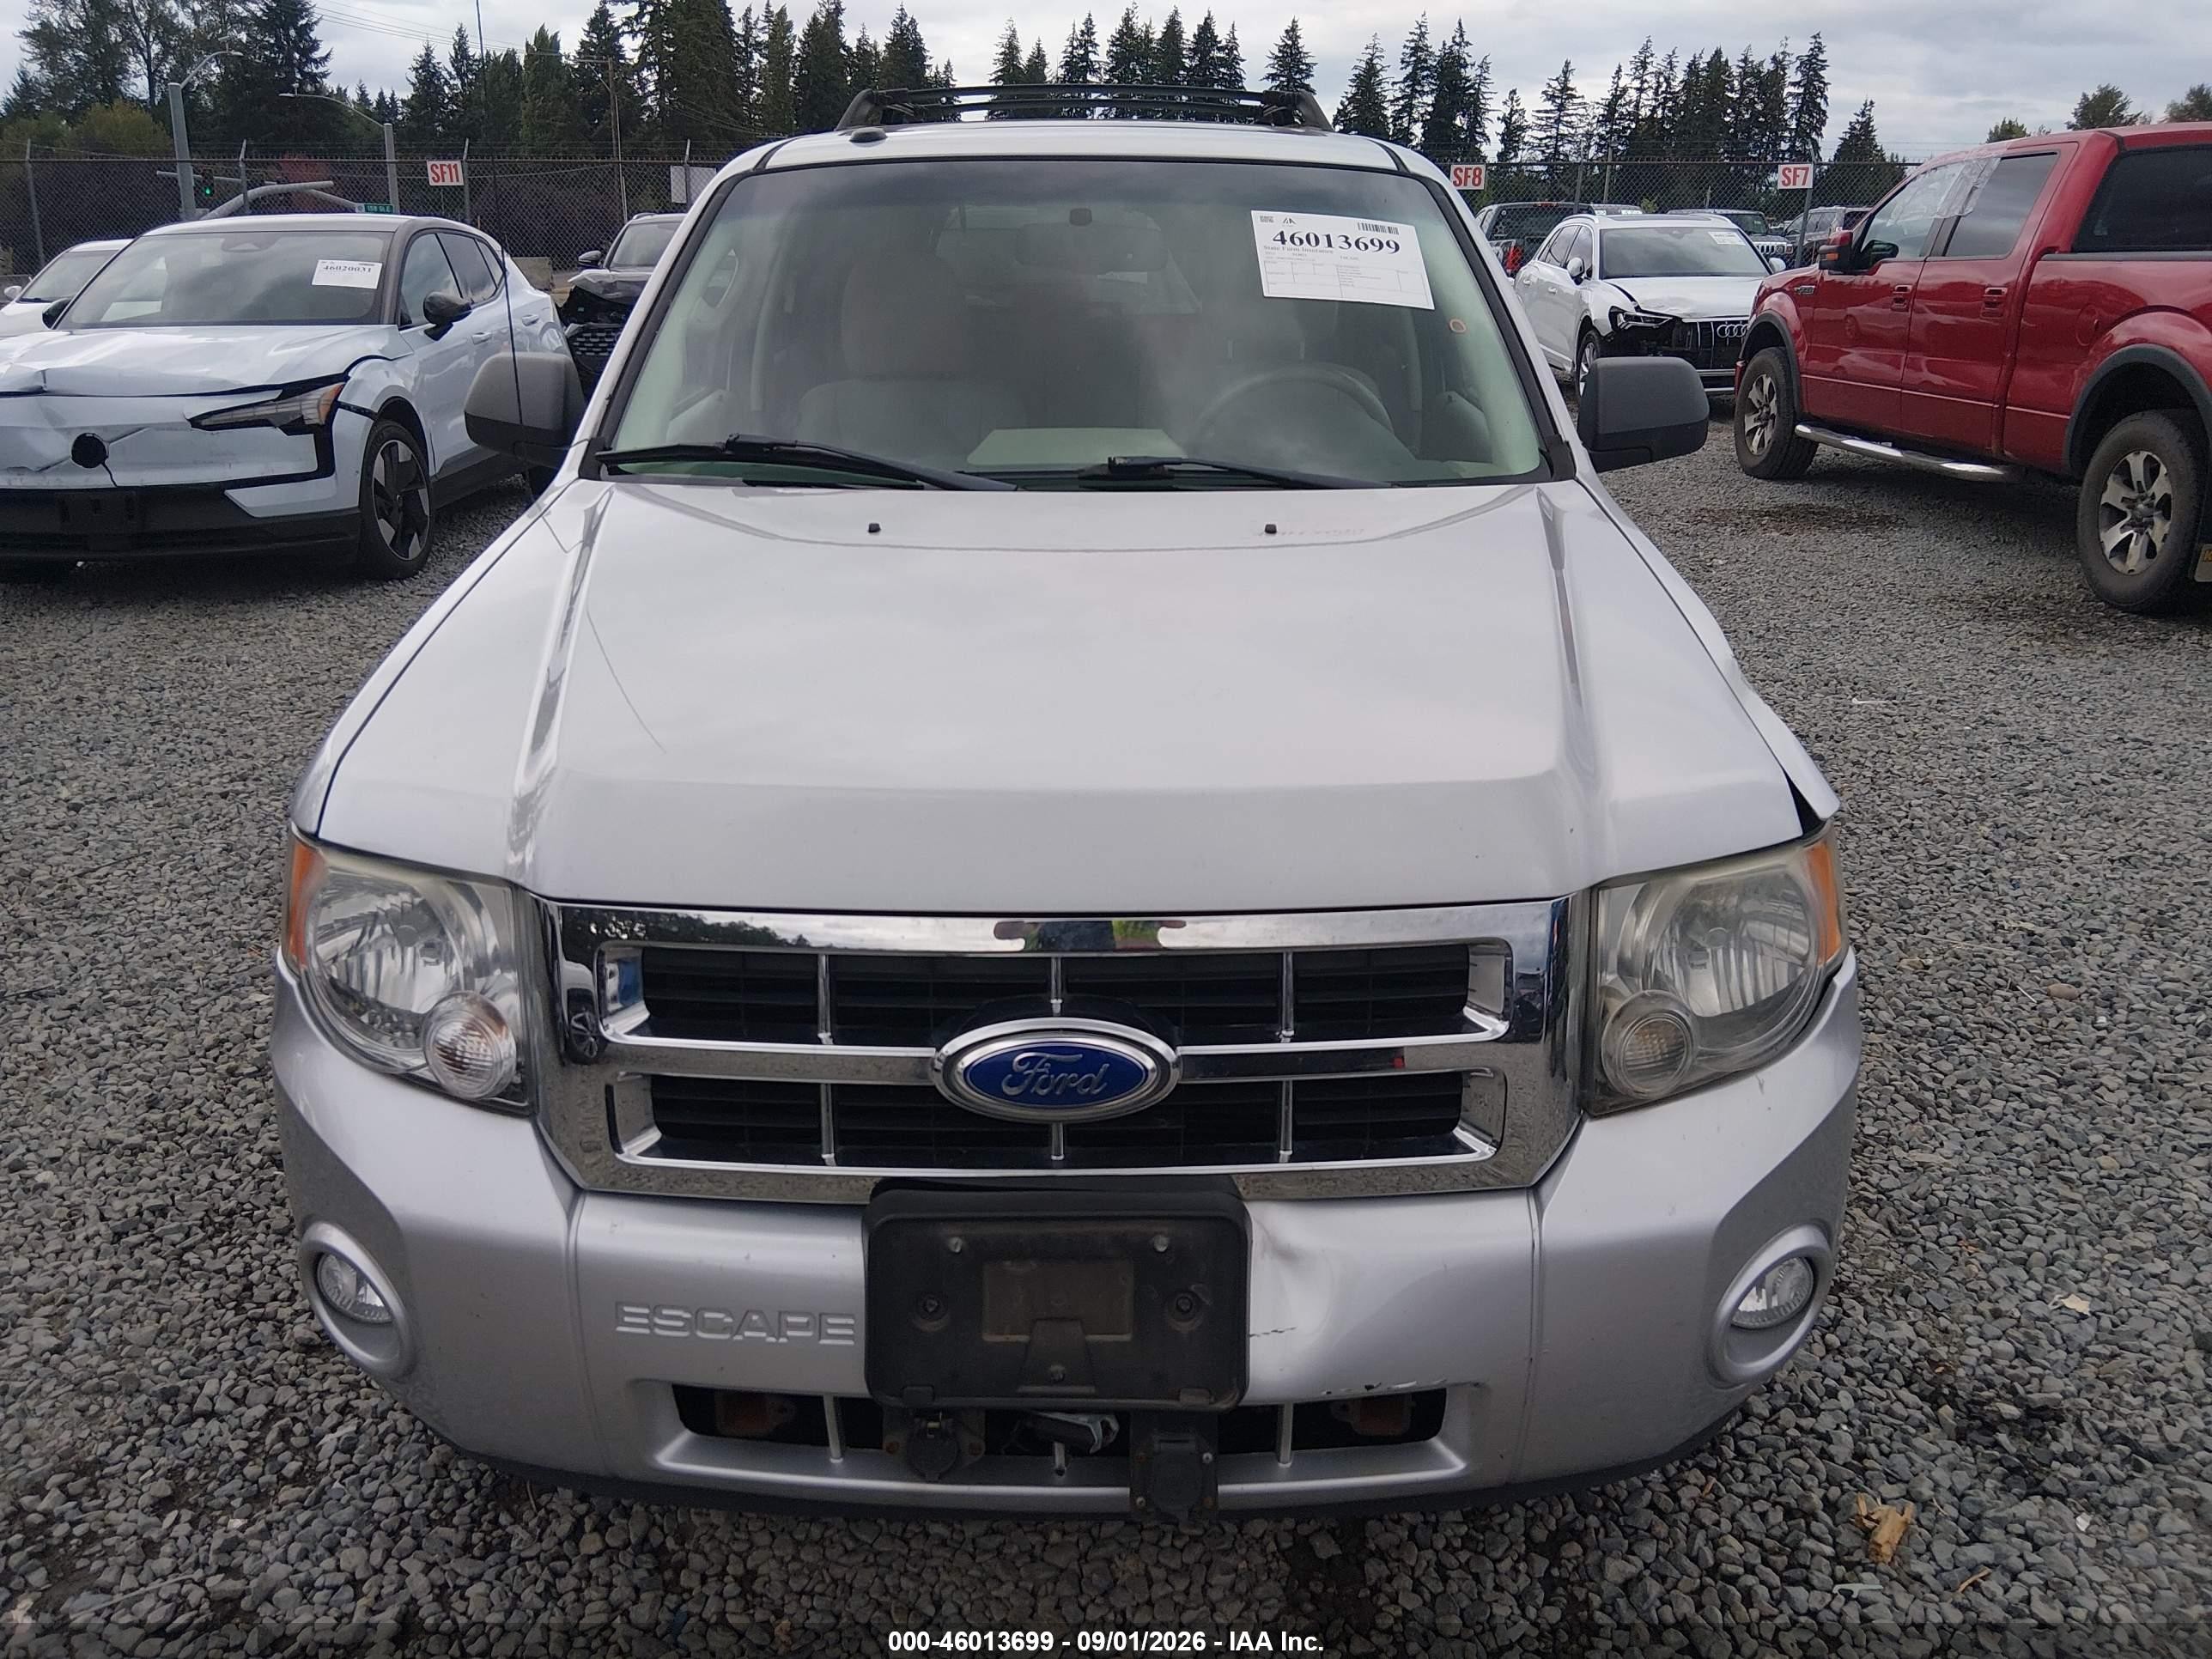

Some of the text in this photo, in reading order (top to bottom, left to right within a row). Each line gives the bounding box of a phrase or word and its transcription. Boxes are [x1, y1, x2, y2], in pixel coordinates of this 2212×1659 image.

[430, 163, 459, 183] SF11
[1453, 167, 1482, 186] SF8
[1782, 167, 1809, 186] SF7
[1273, 230, 1401, 254] 46013699
[1001, 1052, 1109, 1097] Ford
[616, 1302, 854, 1345] ESCAPE
